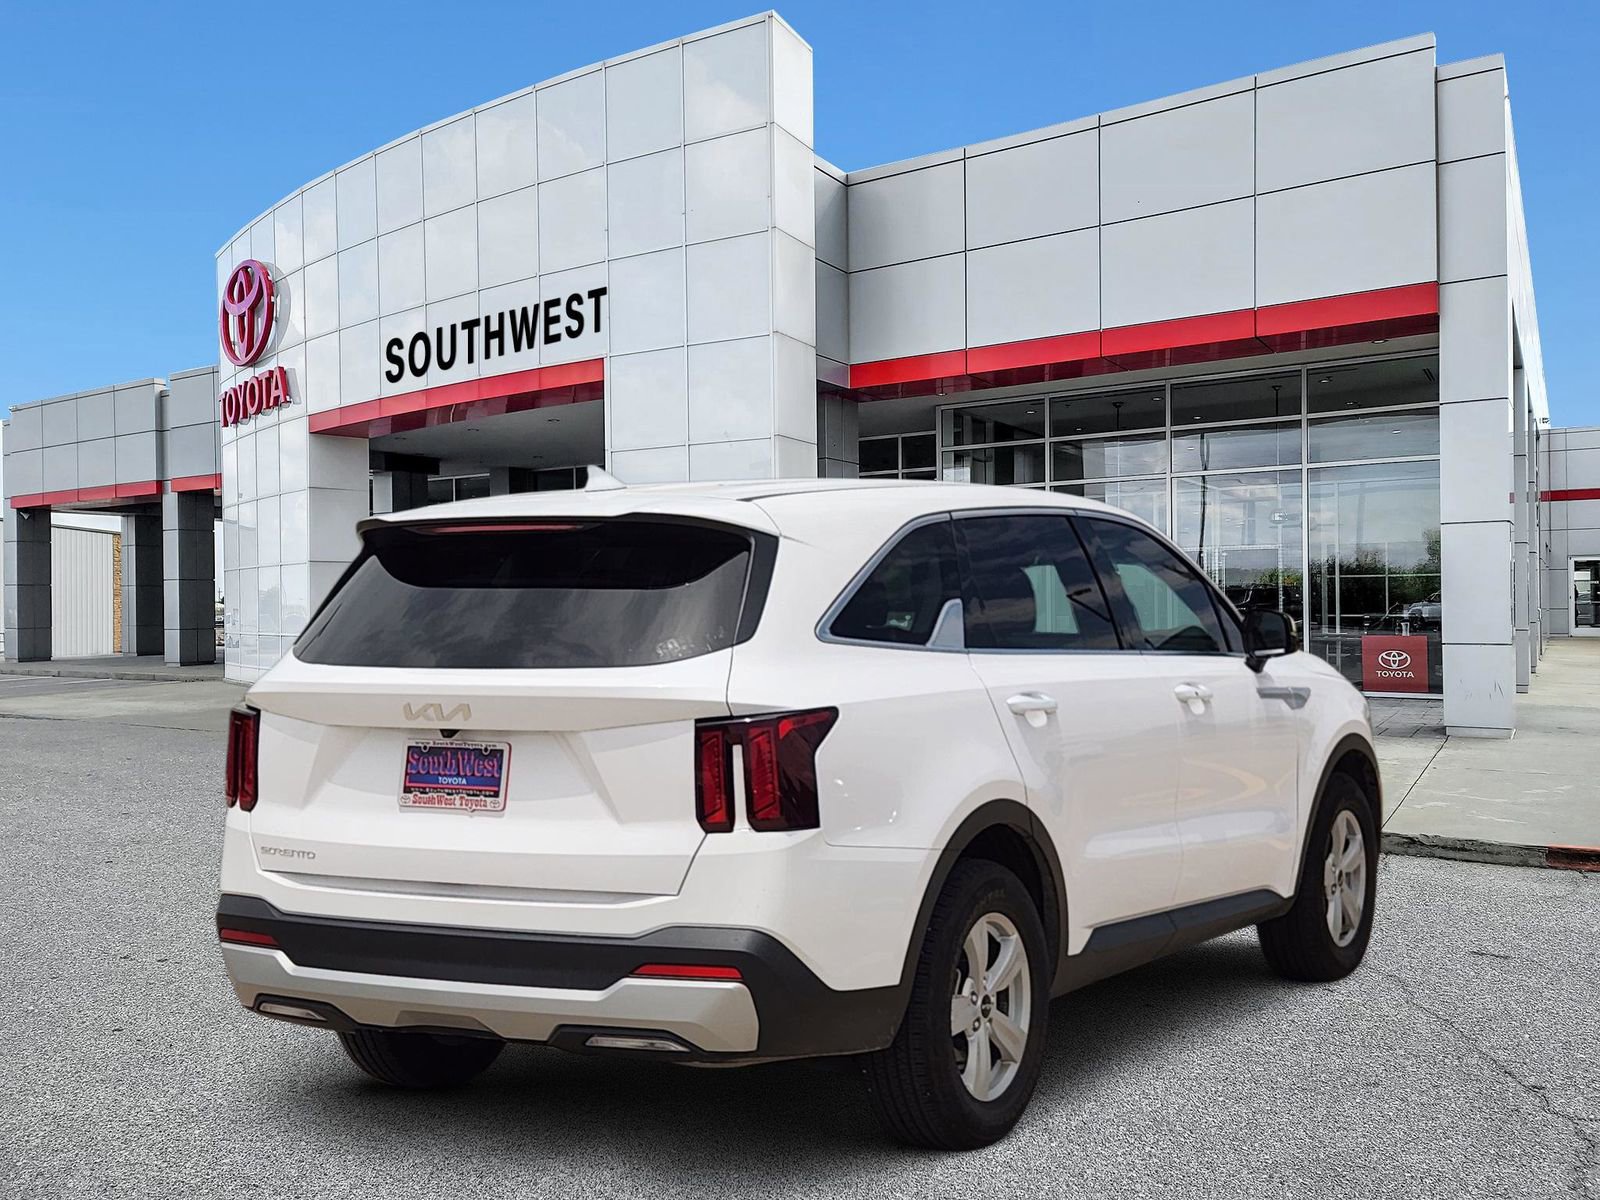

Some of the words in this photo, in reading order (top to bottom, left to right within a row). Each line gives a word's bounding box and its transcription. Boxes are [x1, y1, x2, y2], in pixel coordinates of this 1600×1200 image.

[385, 286, 608, 384] SOUTHWEST
[218, 366, 291, 428] TOYOTA
[1376, 670, 1415, 678] TOYOTA
[403, 702, 472, 722] KIA
[438, 776, 467, 785] TOYOTA
[459, 795, 488, 809] Toyota
[261, 846, 316, 860] SORENTO
